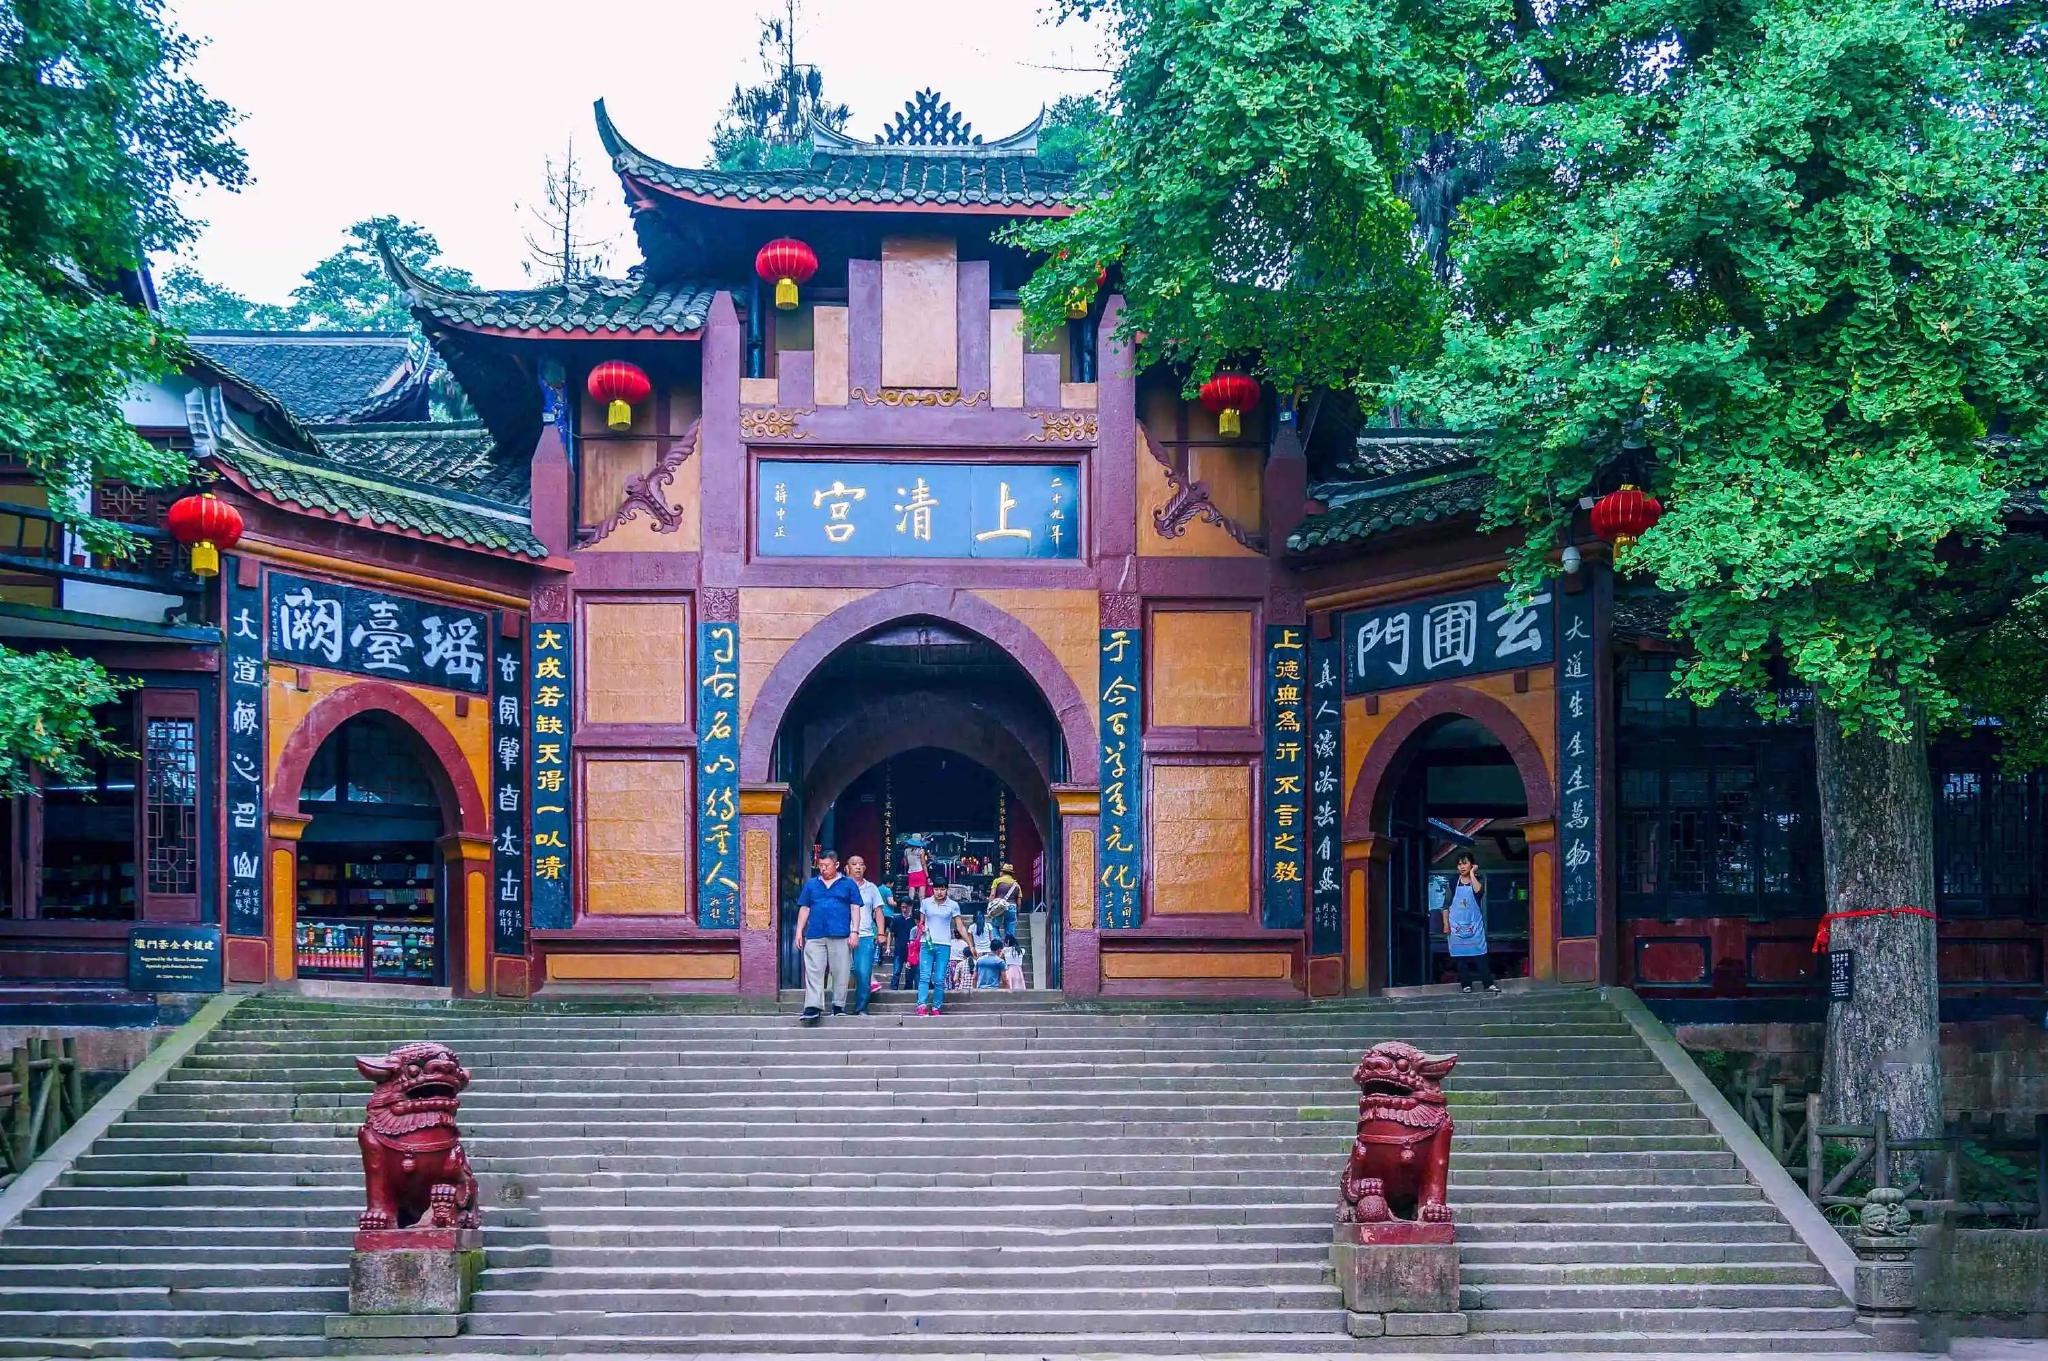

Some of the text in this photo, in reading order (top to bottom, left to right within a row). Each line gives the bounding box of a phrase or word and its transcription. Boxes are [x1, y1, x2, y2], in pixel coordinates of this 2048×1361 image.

[1049, 477, 1065, 546] 二十九年
[533, 629, 566, 881] 大成若缺天得一以清
